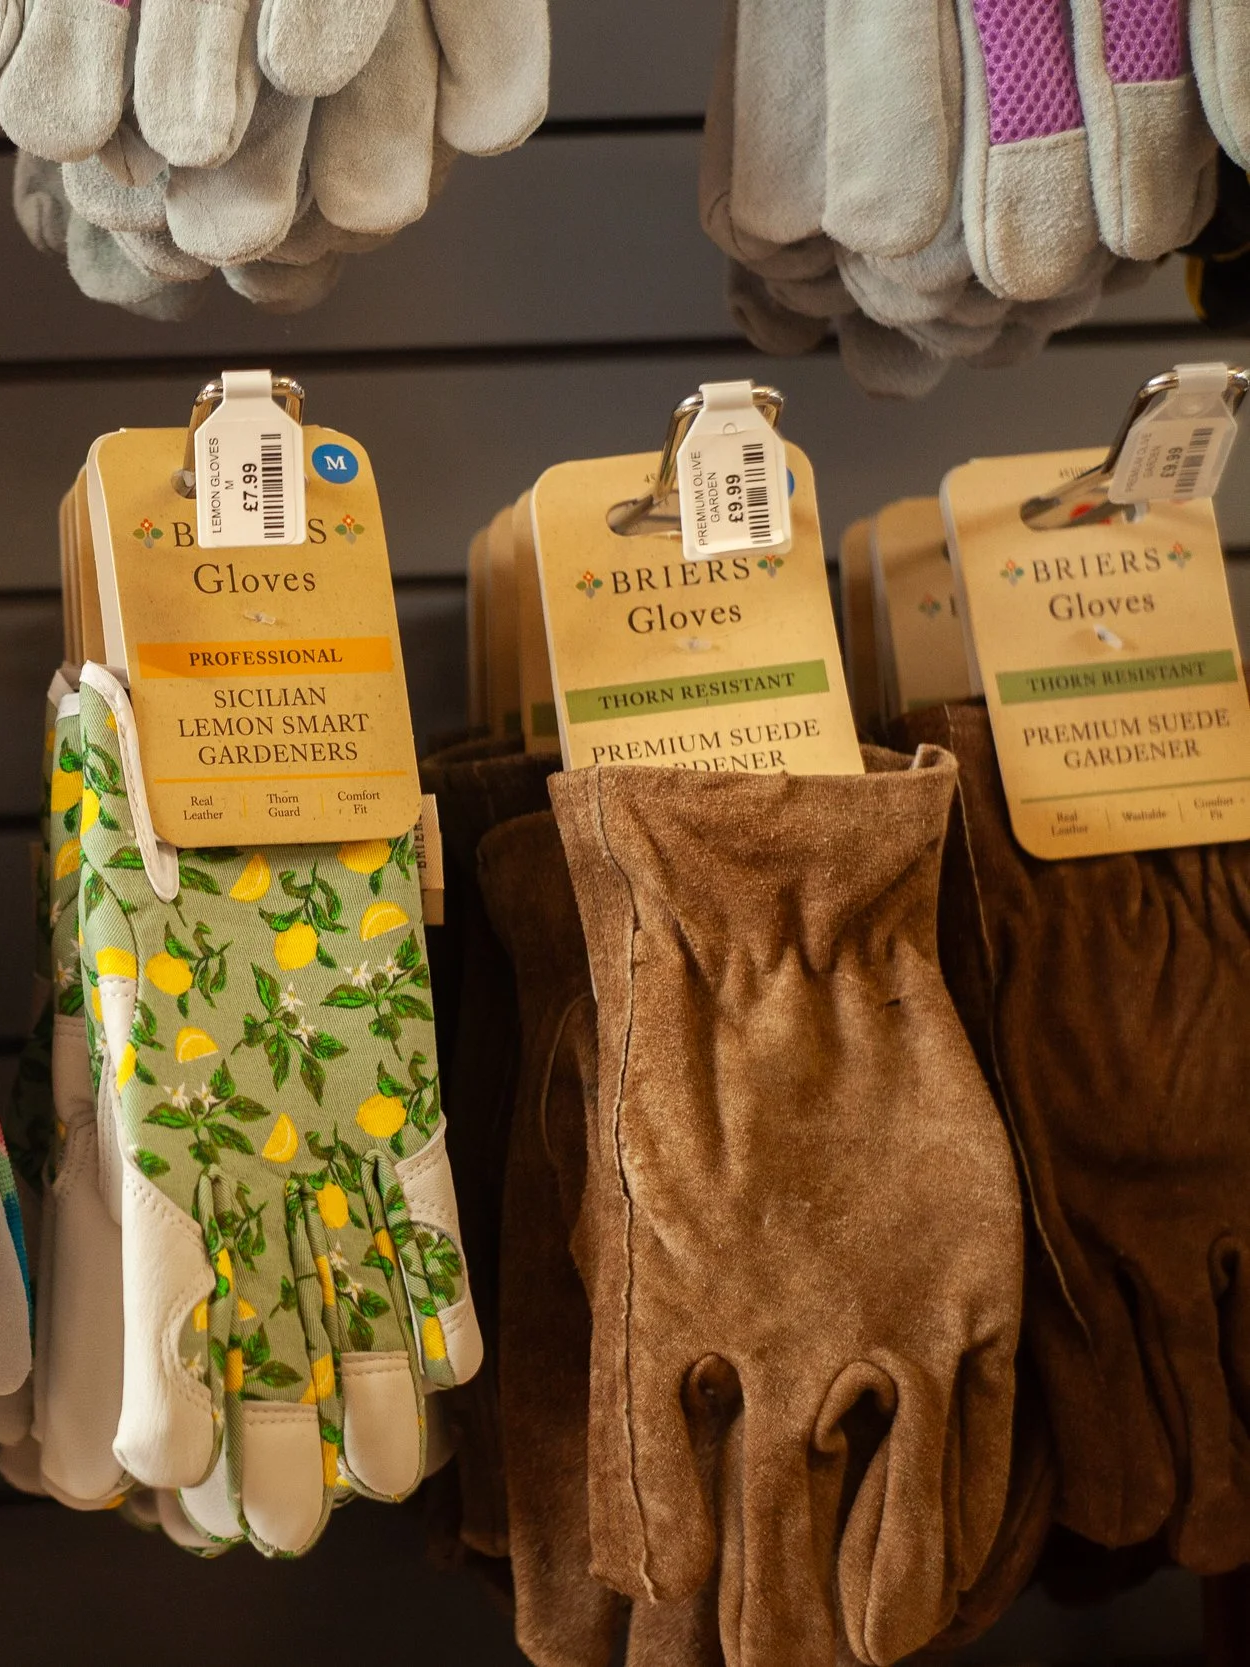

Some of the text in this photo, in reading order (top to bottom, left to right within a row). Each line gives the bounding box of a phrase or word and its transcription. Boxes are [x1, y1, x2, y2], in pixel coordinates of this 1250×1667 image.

[324, 455, 347, 471] M
[1160, 447, 1183, 478] £9.99
[209, 437, 222, 534] LEMON GLOVES
[224, 479, 234, 490] M
[242, 463, 258, 512] £7.99
[690, 450, 709, 546] PREMIUM OLIVE
[707, 471, 720, 523] GARDEN
[725, 474, 744, 523] £9.99
[193, 563, 316, 594] Gloves
[611, 557, 751, 594] BRIERS
[1033, 546, 1162, 584] BRIERS
[627, 603, 742, 634] Gloves
[1049, 590, 1156, 622] Gloves
[189, 648, 343, 667] PROFESSIONAL
[598, 672, 795, 710] THORN RESISTANT
[1026, 661, 1208, 694] THORN RESISTANT
[213, 686, 327, 709] SICILIAN
[177, 712, 370, 738] LEMON SMART
[1022, 708, 1231, 748] PREMIUM SUEDE
[197, 742, 359, 766] GARDENERS
[591, 718, 821, 764] PREMIUM SUEDE
[1063, 739, 1202, 771] GARDENER
[673, 749, 786, 773] DENER
[190, 796, 213, 807] Real
[266, 793, 299, 805] Thorn
[337, 789, 381, 802] Comfort
[353, 804, 368, 815] Fit
[183, 808, 224, 822] Leather
[268, 805, 301, 818] Guard
[413, 814, 427, 869] BRIER
